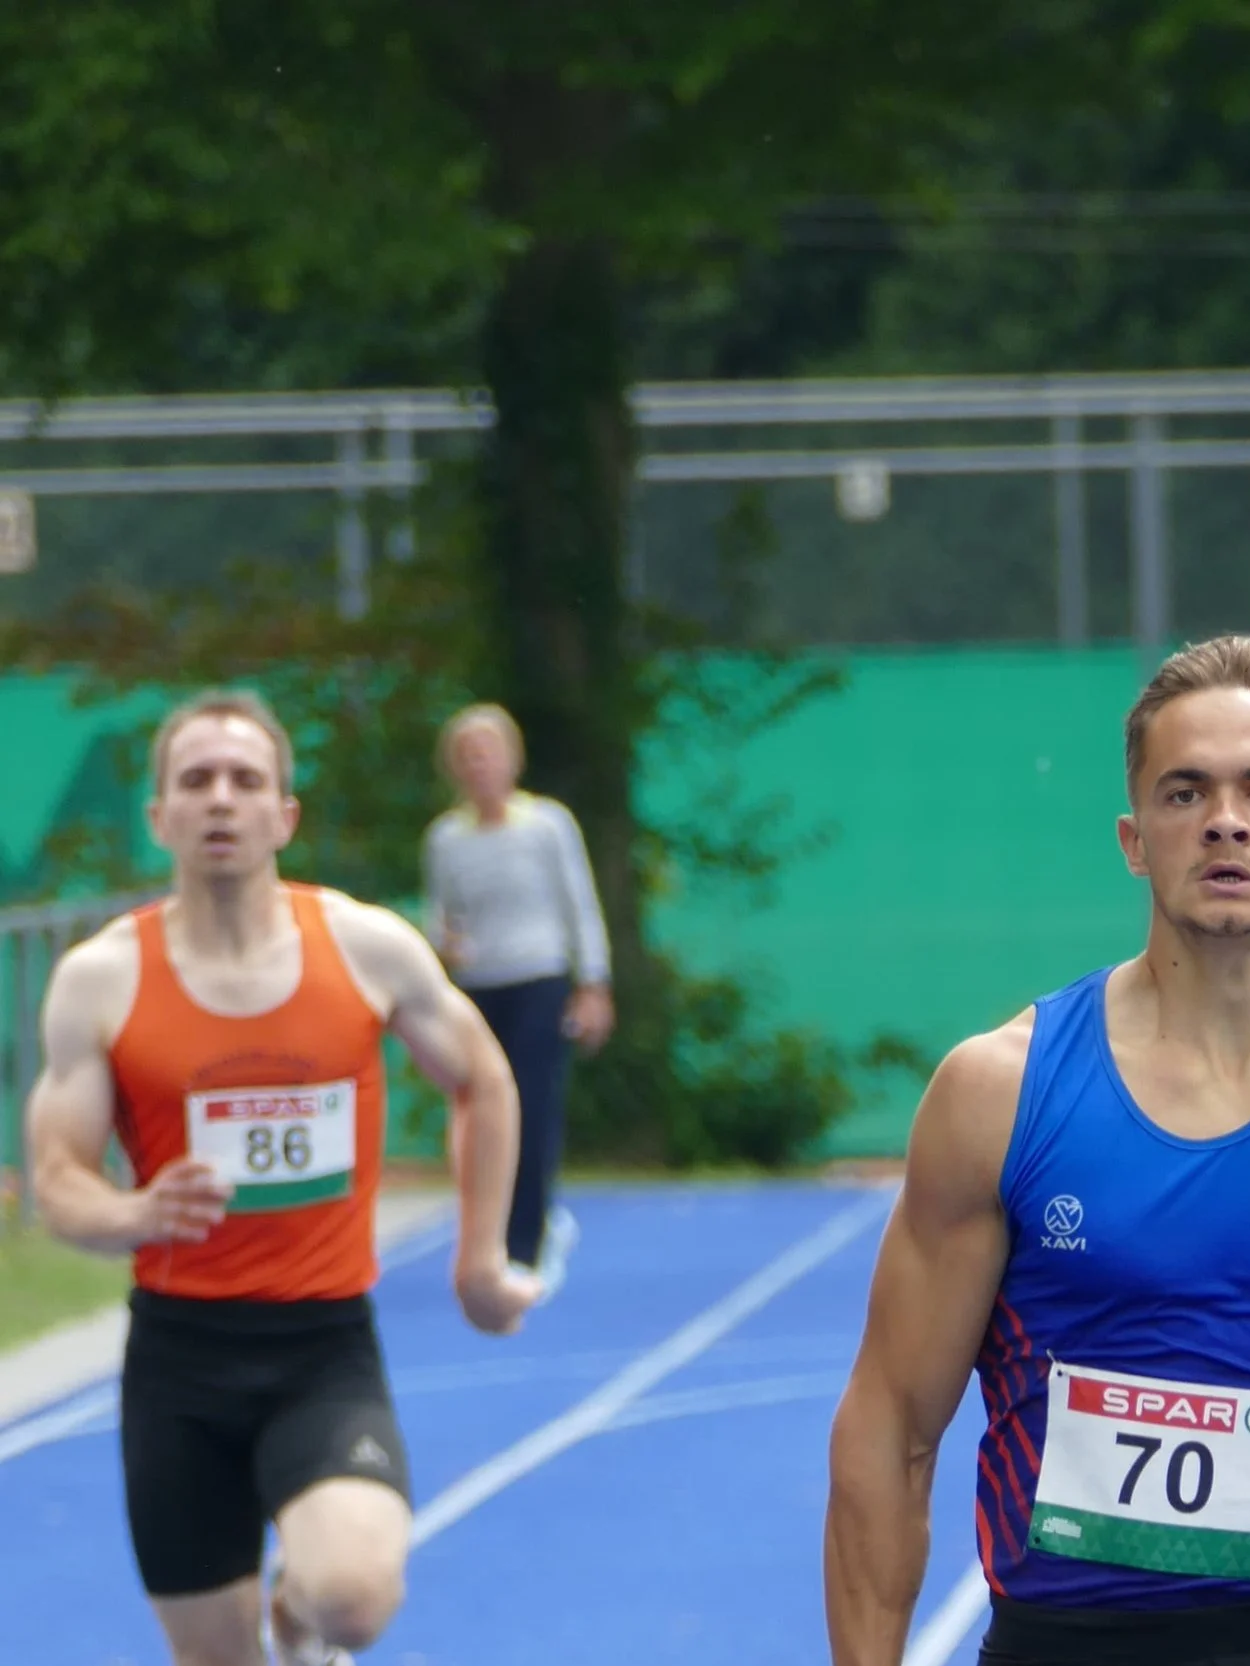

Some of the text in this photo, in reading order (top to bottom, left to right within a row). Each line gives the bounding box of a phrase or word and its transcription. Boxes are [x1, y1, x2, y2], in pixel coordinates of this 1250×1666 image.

[228, 1096, 319, 1119] SPAR
[247, 1126, 313, 1174] 86
[1040, 1236, 1086, 1251] XAVI
[1102, 1387, 1234, 1428] SPAR
[1115, 1431, 1215, 1514] 70
